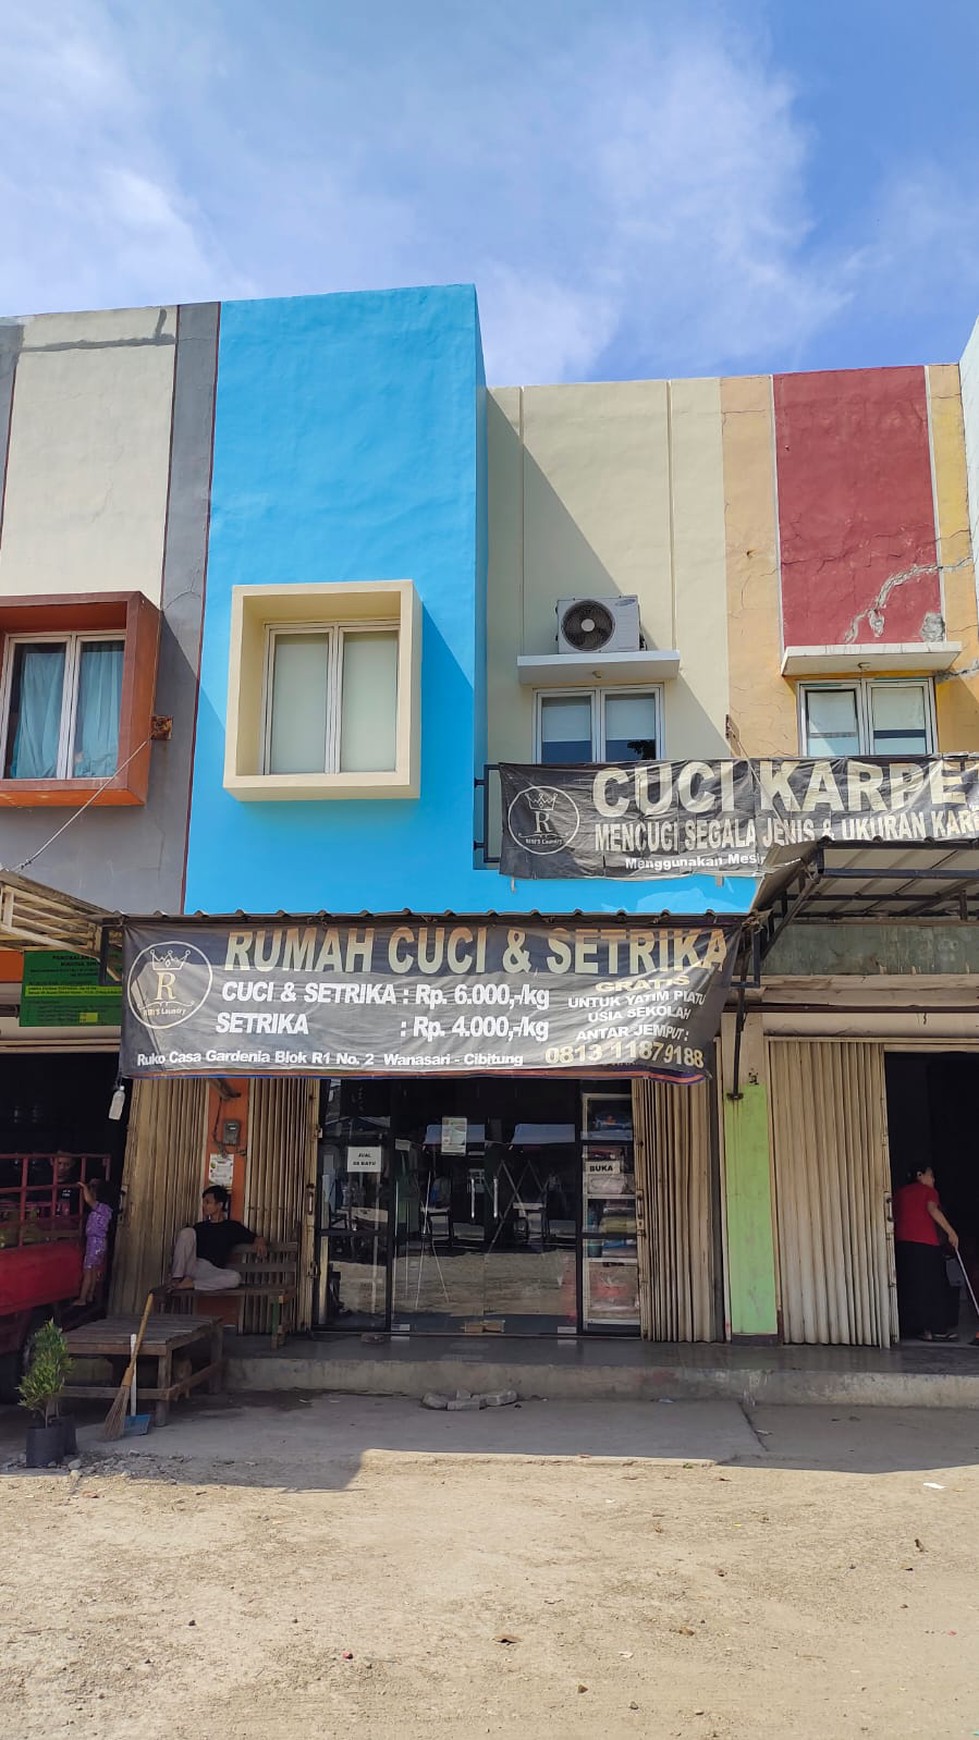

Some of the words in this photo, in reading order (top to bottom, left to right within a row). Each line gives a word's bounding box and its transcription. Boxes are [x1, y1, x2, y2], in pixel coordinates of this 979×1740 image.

[593, 761, 735, 818] CUCI
[534, 811, 553, 833] R
[595, 821, 678, 851] MENCUCI
[685, 818, 756, 851] SEGALA
[763, 818, 815, 849] JENIS
[842, 811, 926, 840] UKURAN
[625, 855, 722, 871] Menggunakan
[224, 927, 375, 972] RUMAH
[388, 927, 487, 974] CUCI
[503, 928, 532, 974] &
[546, 927, 727, 974] SETRIKA
[154, 972, 176, 1000] R
[595, 975, 690, 992] GRATIS
[222, 981, 275, 1002] CUCI
[280, 982, 297, 1002] &
[304, 982, 397, 1004] SETRIKA
[415, 984, 447, 1010] Rp.
[568, 996, 621, 1009] UNTUK
[626, 990, 669, 1005] YATIM
[673, 990, 706, 1006] PIATU
[588, 1012, 623, 1023] USIA
[626, 1005, 691, 1020] SEKOLAH
[215, 1012, 309, 1035] SETRIKA
[413, 1016, 445, 1042] Rp.
[575, 1026, 630, 1042] ANTAR
[137, 1053, 165, 1067] Ruko
[169, 1051, 201, 1064] Casa
[205, 1050, 271, 1063] Gardenia
[275, 1050, 307, 1064] Blok
[311, 1052, 330, 1064] R1
[336, 1053, 359, 1065] No.
[363, 1053, 374, 1065] 2
[384, 1053, 450, 1066] Wanasari
[464, 1053, 523, 1067] Cibitung
[545, 1044, 602, 1065] 0813
